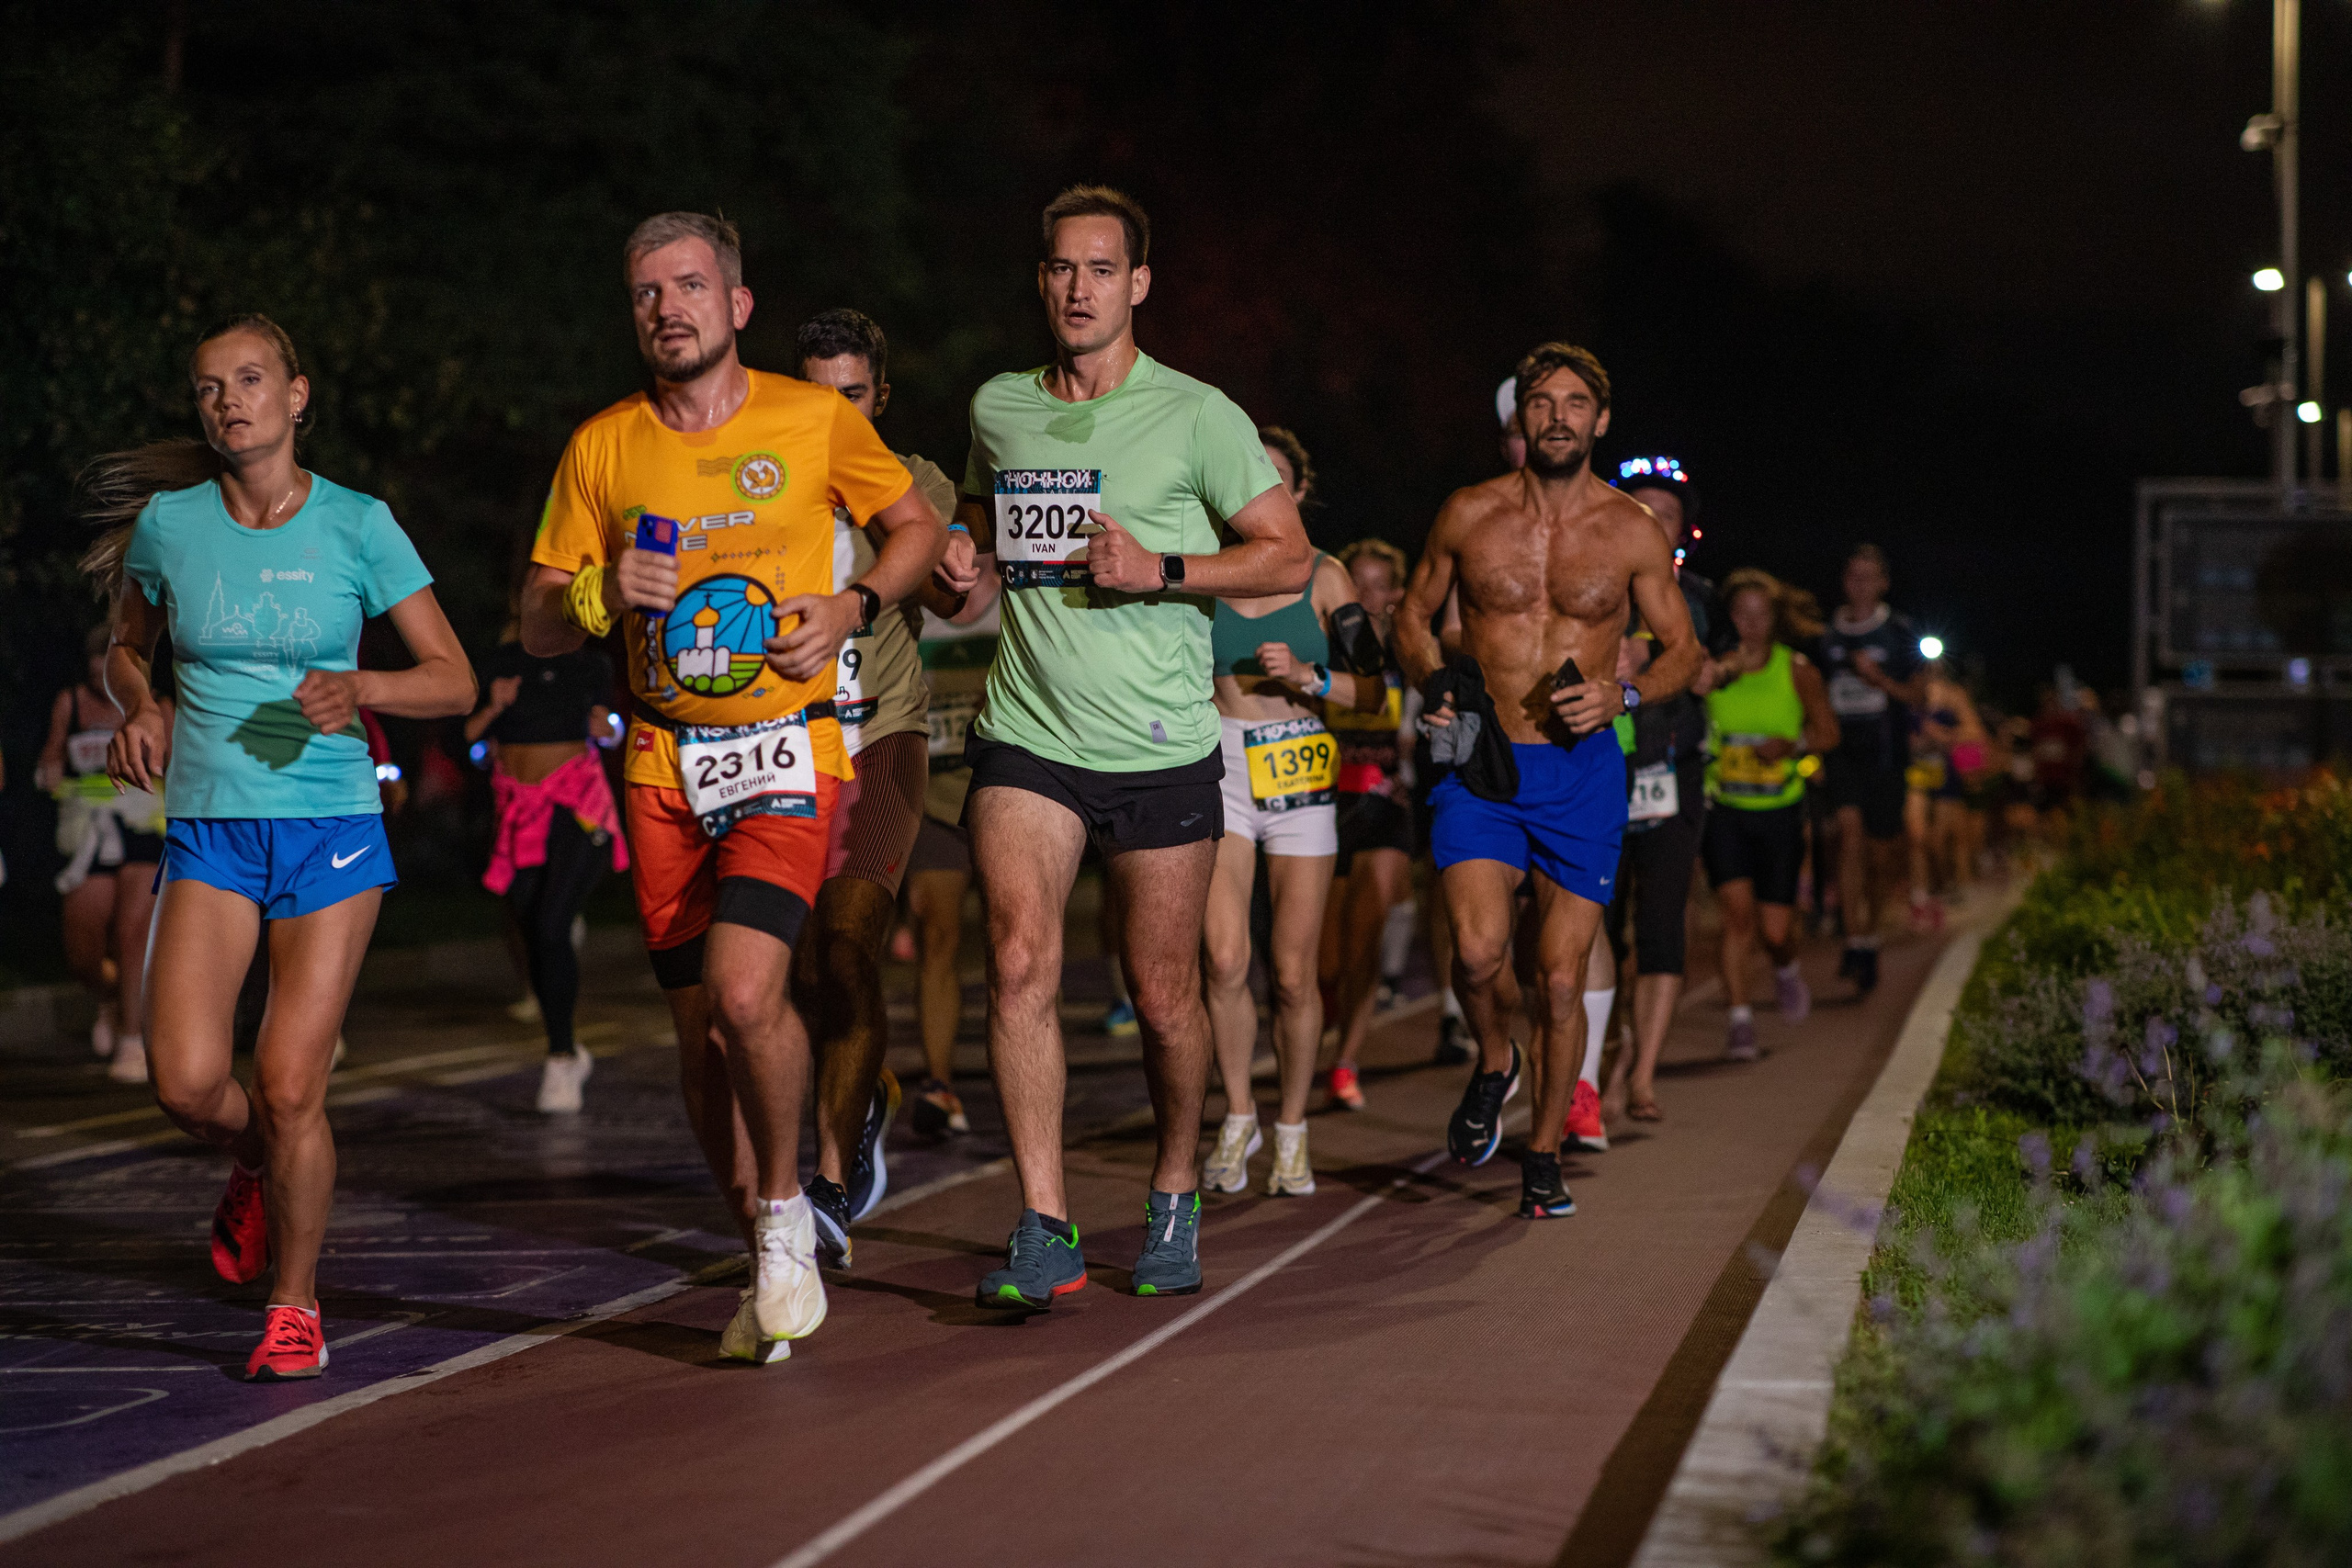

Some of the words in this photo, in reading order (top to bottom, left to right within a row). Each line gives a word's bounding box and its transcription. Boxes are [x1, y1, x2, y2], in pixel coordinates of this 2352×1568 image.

[1008, 504, 1085, 539] 3202
[1032, 544, 1056, 553] IVAN
[277, 568, 314, 583] essity
[842, 649, 862, 681] 9
[695, 737, 796, 790] 2316
[1264, 742, 1329, 779] 1399
[719, 773, 775, 799] ЕВГЕНИЙ
[1639, 781, 1665, 802] 16
